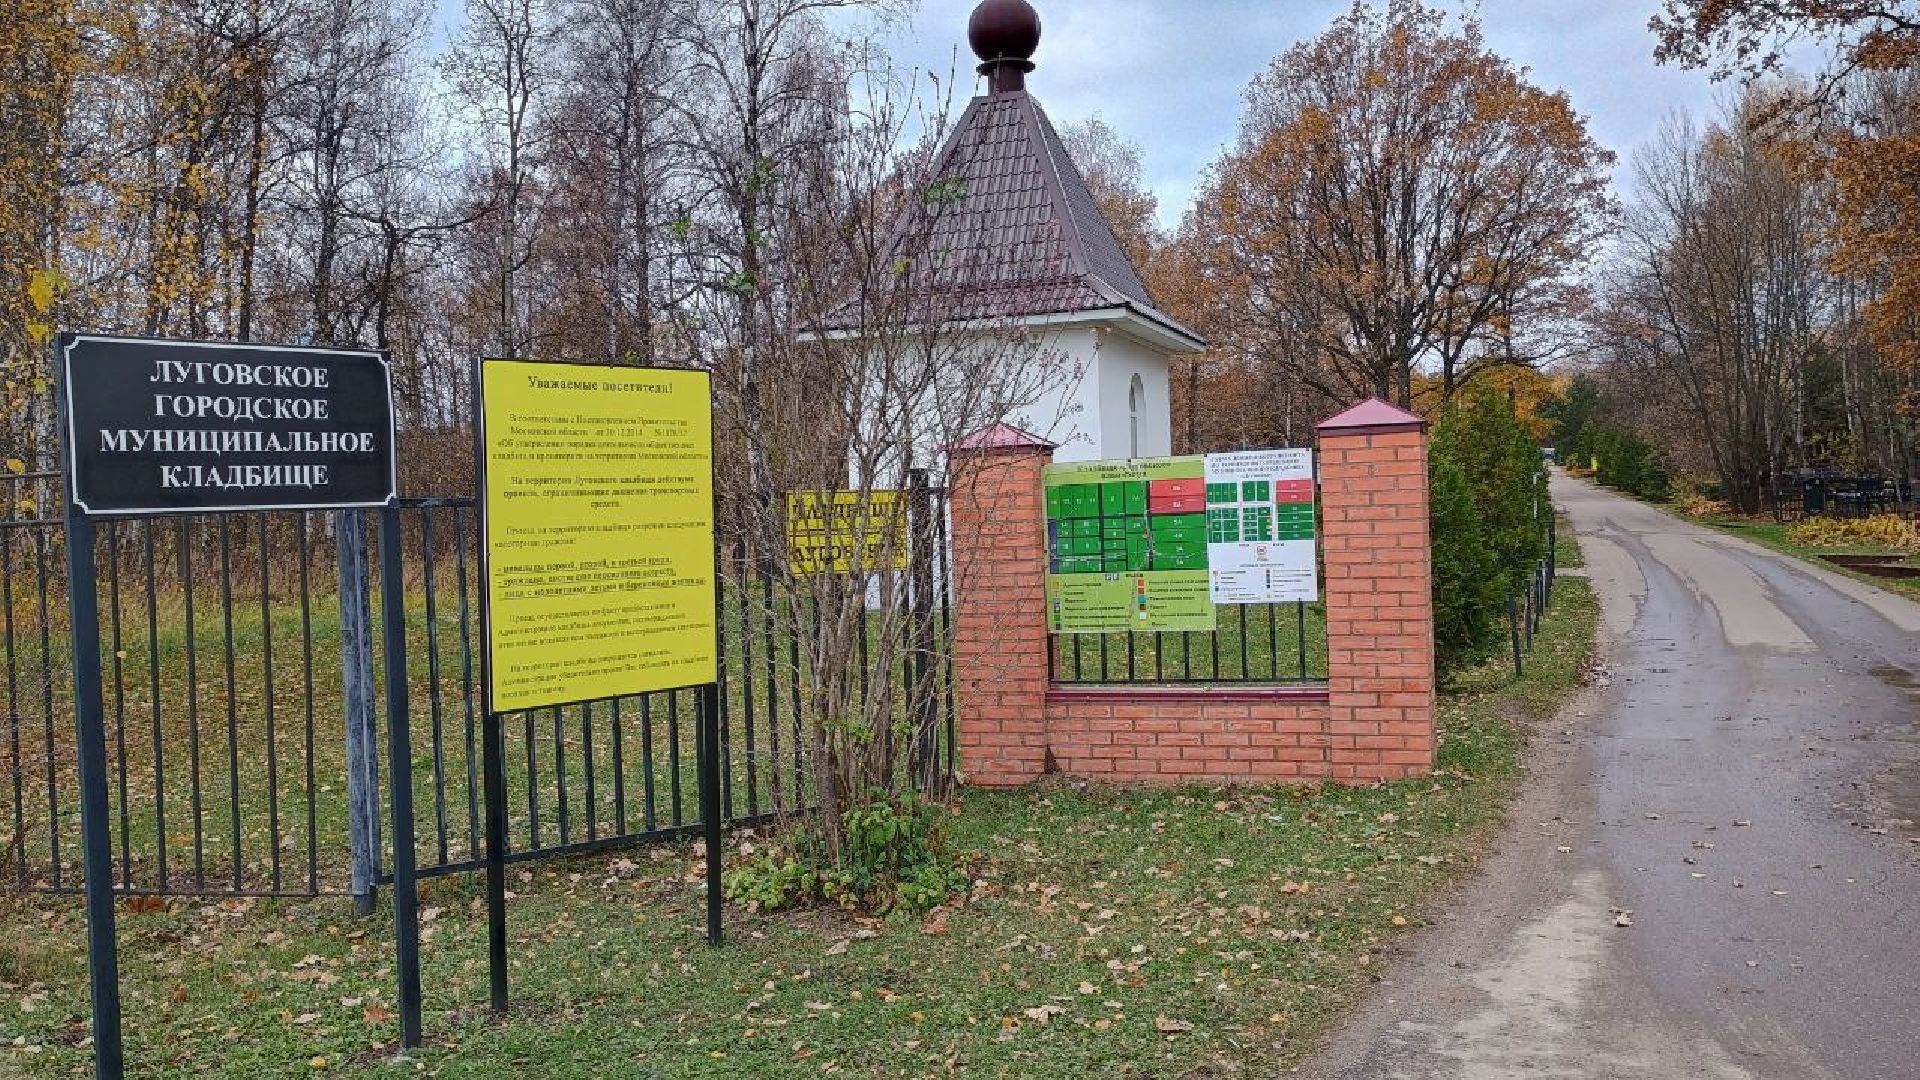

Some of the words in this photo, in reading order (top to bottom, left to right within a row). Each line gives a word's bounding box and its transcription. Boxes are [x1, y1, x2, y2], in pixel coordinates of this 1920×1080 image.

[150, 360, 329, 388] ЛУГОВСКОЕ
[527, 375, 598, 391] Уважаемые
[602, 382, 673, 394] посетители!
[154, 394, 329, 423] ГОРОДСКОЕ
[99, 429, 375, 456] МУНИЦИПАЛЬНОЕ
[159, 464, 329, 490] КЛАДБИЩЕ
